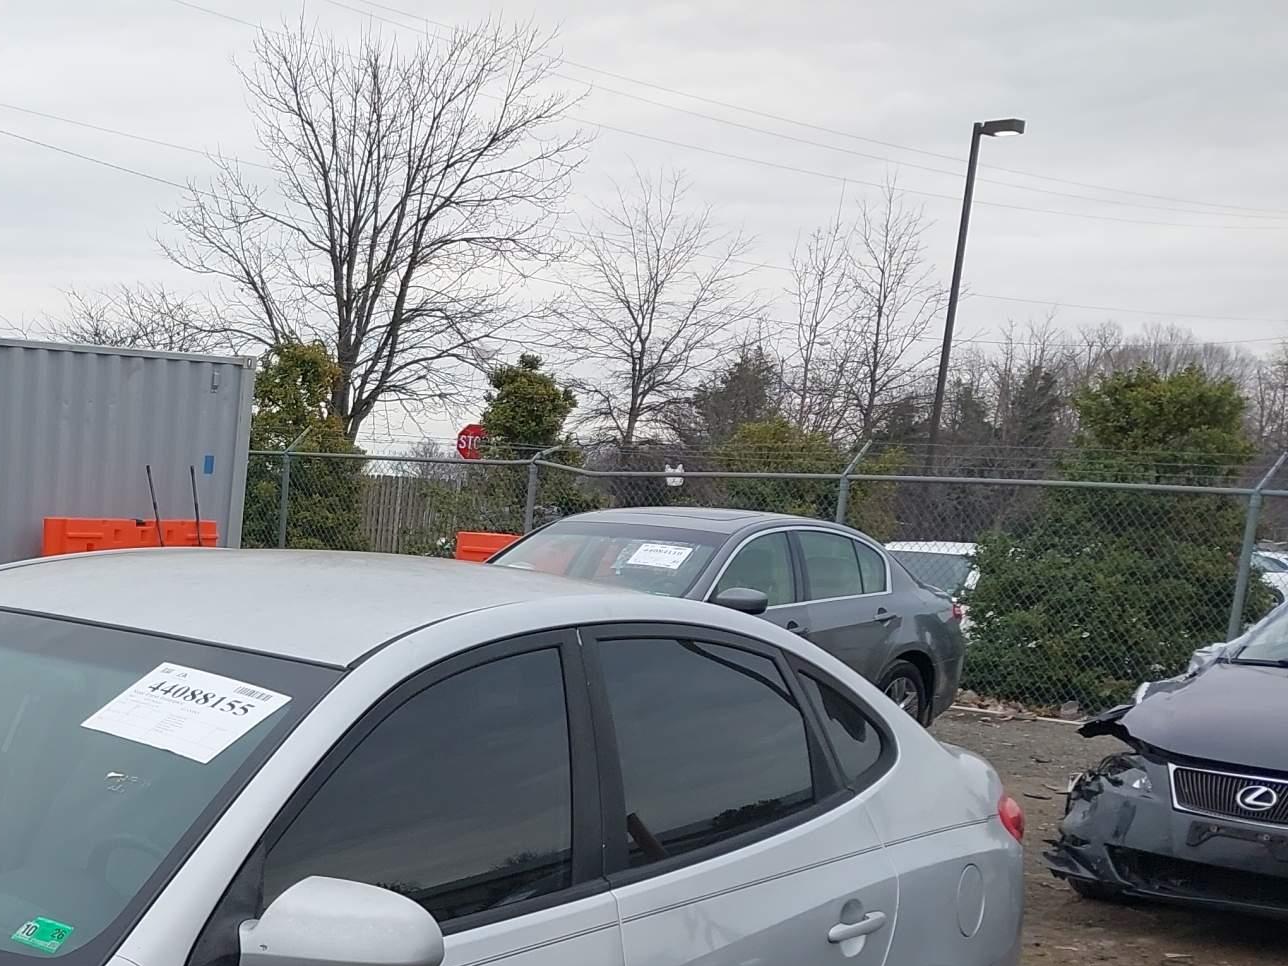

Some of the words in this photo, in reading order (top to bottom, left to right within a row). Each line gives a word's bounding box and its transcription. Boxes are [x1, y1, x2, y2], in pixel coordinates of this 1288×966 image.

[458, 435, 487, 450] STO
[148, 680, 256, 717] 44088155
[22, 923, 38, 937] 10
